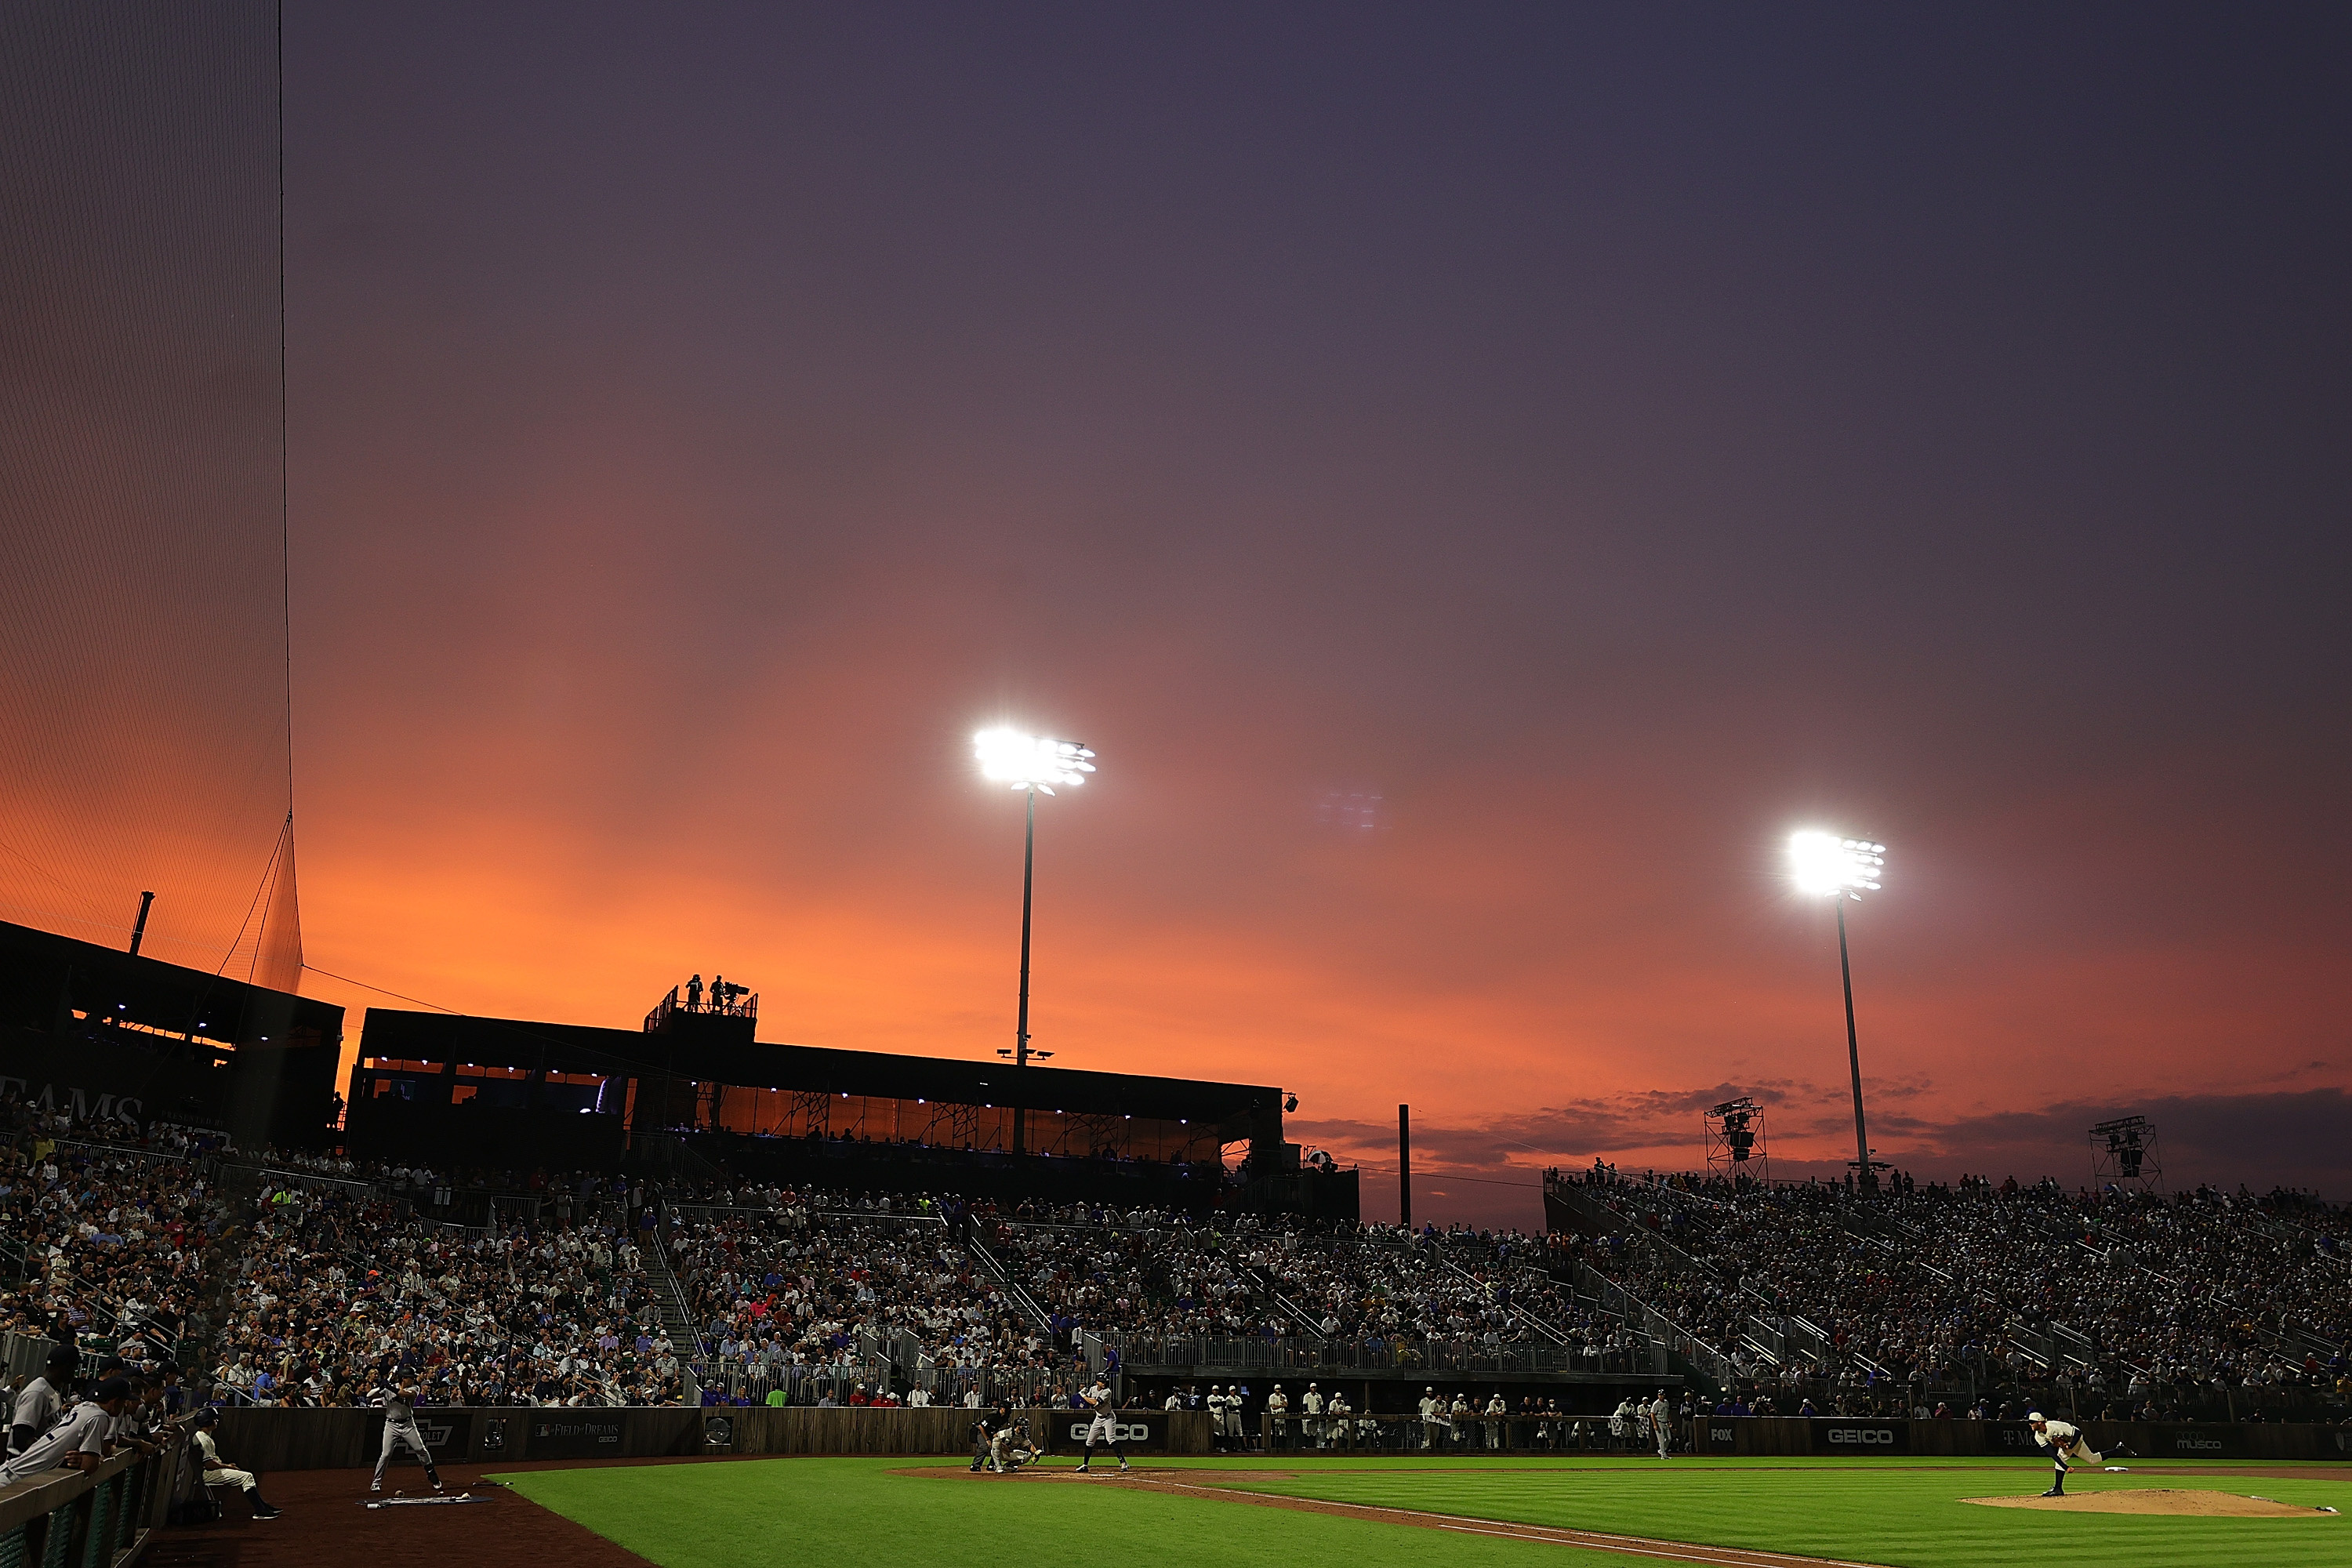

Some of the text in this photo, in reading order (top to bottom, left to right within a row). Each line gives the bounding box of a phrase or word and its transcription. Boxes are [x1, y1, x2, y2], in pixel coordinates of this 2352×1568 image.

[554, 1424, 579, 1436] FIELD
[585, 1423, 619, 1436] DREAMS
[1070, 1423, 1149, 1441] GCO
[1711, 1428, 1733, 1441] FOX
[1828, 1428, 1893, 1444] GEICO
